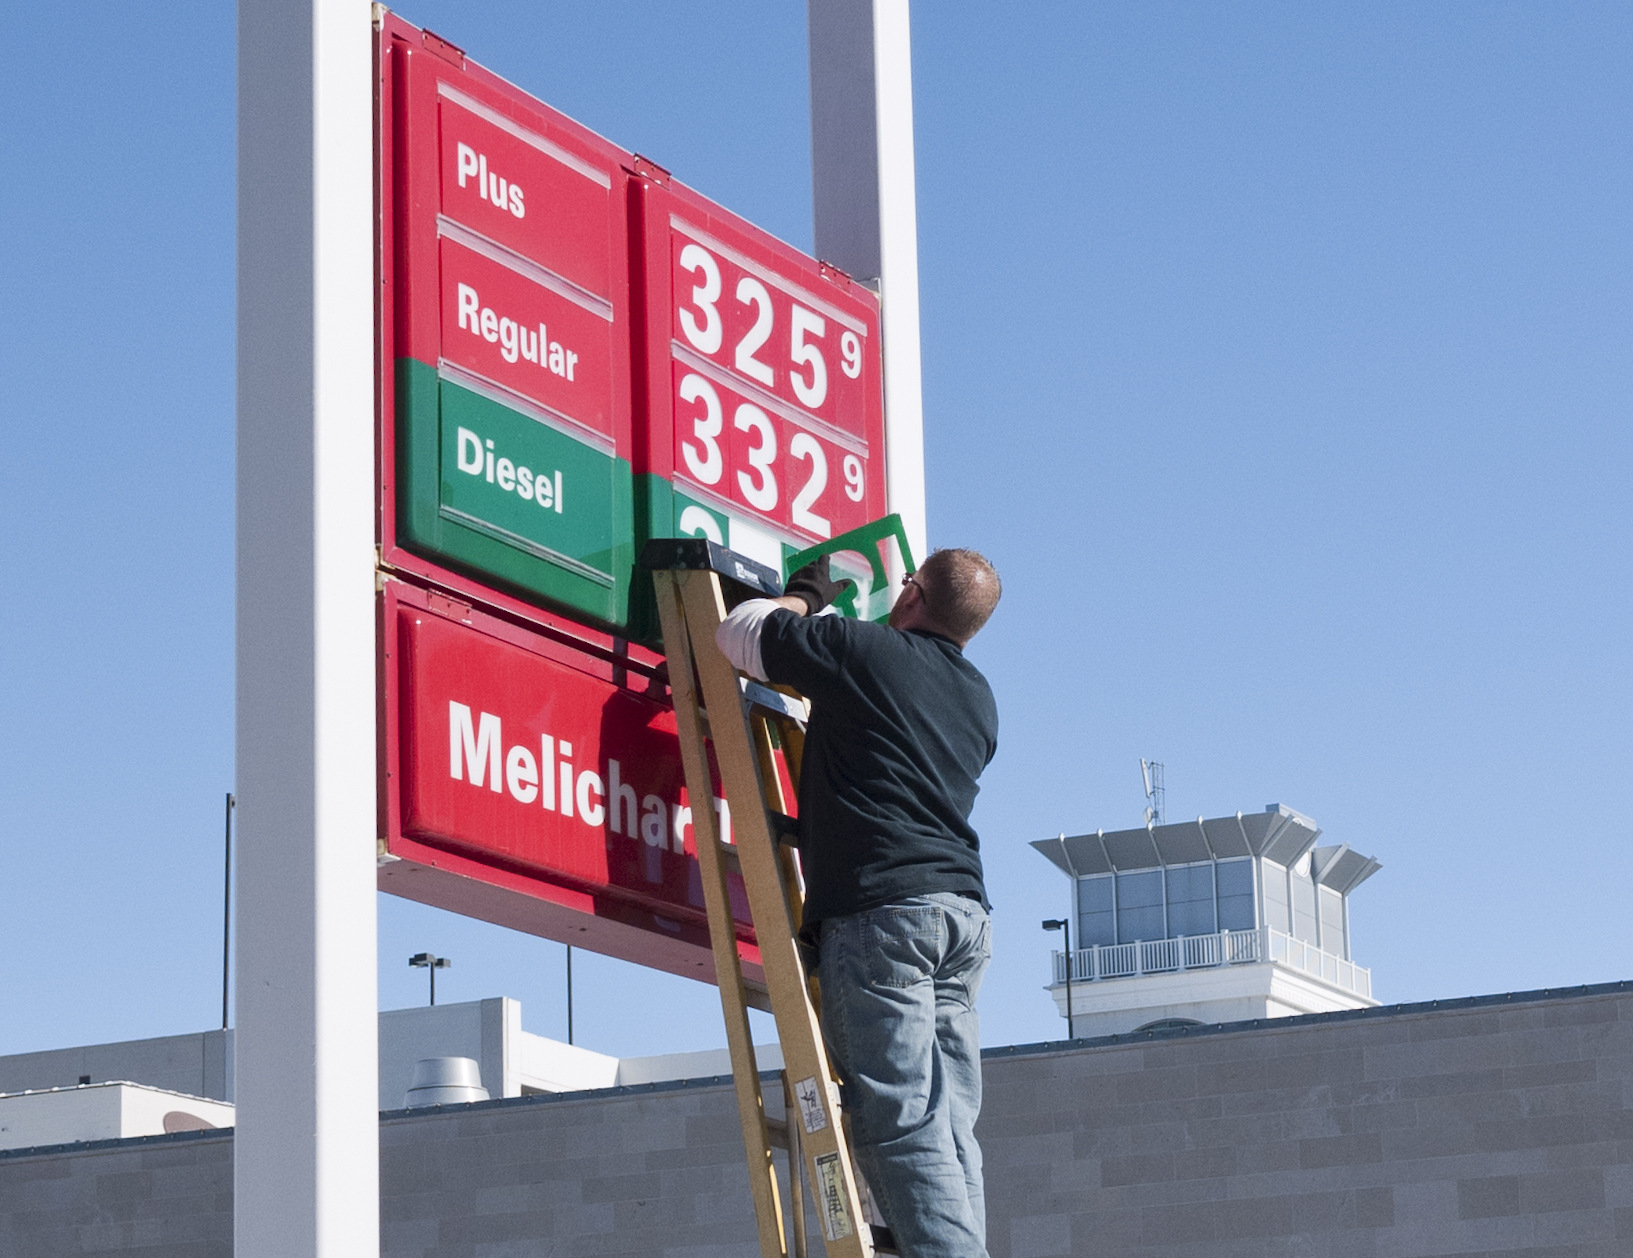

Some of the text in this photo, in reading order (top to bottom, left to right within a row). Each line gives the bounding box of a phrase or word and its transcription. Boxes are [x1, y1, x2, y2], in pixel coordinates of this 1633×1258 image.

[457, 141, 526, 219] Plus
[457, 282, 578, 382] Regular
[457, 426, 563, 514] Diesel
